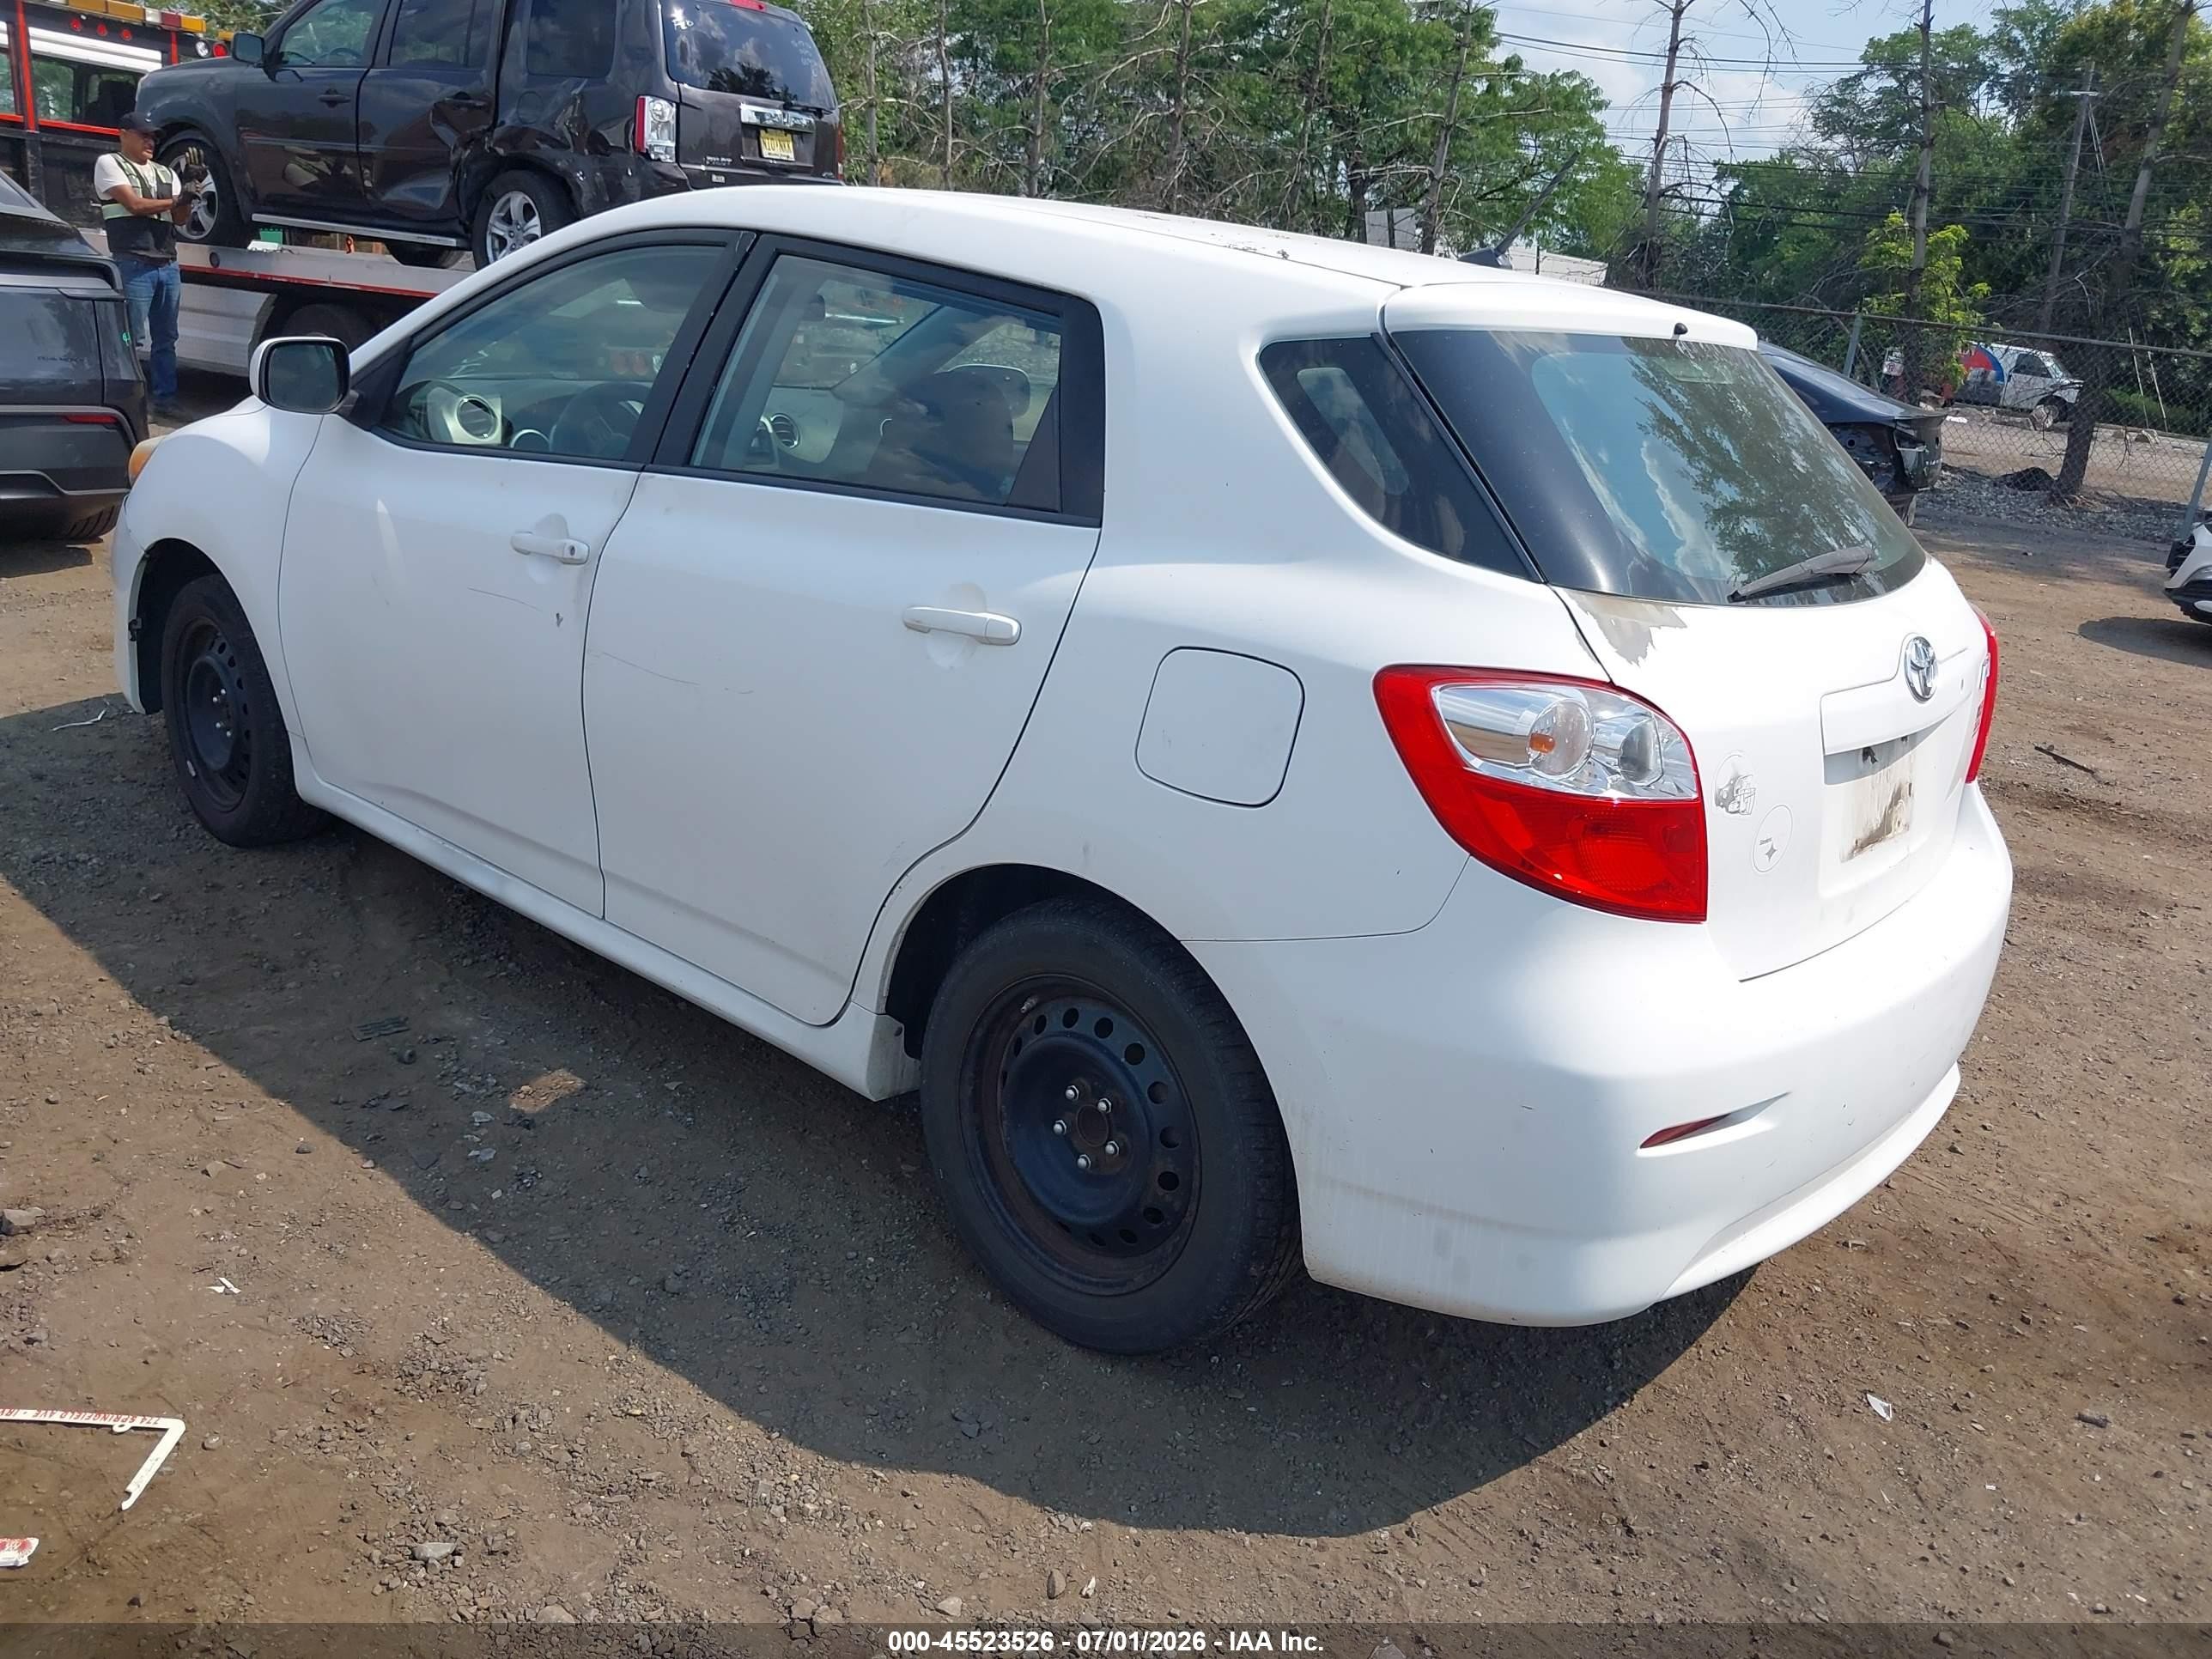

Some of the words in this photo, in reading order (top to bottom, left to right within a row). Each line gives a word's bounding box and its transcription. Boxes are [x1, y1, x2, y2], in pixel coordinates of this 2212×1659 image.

[33, 1409, 57, 1419] AVE
[58, 1410, 137, 1424] SPRINGFIELD
[139, 1415, 161, 1425] 774
